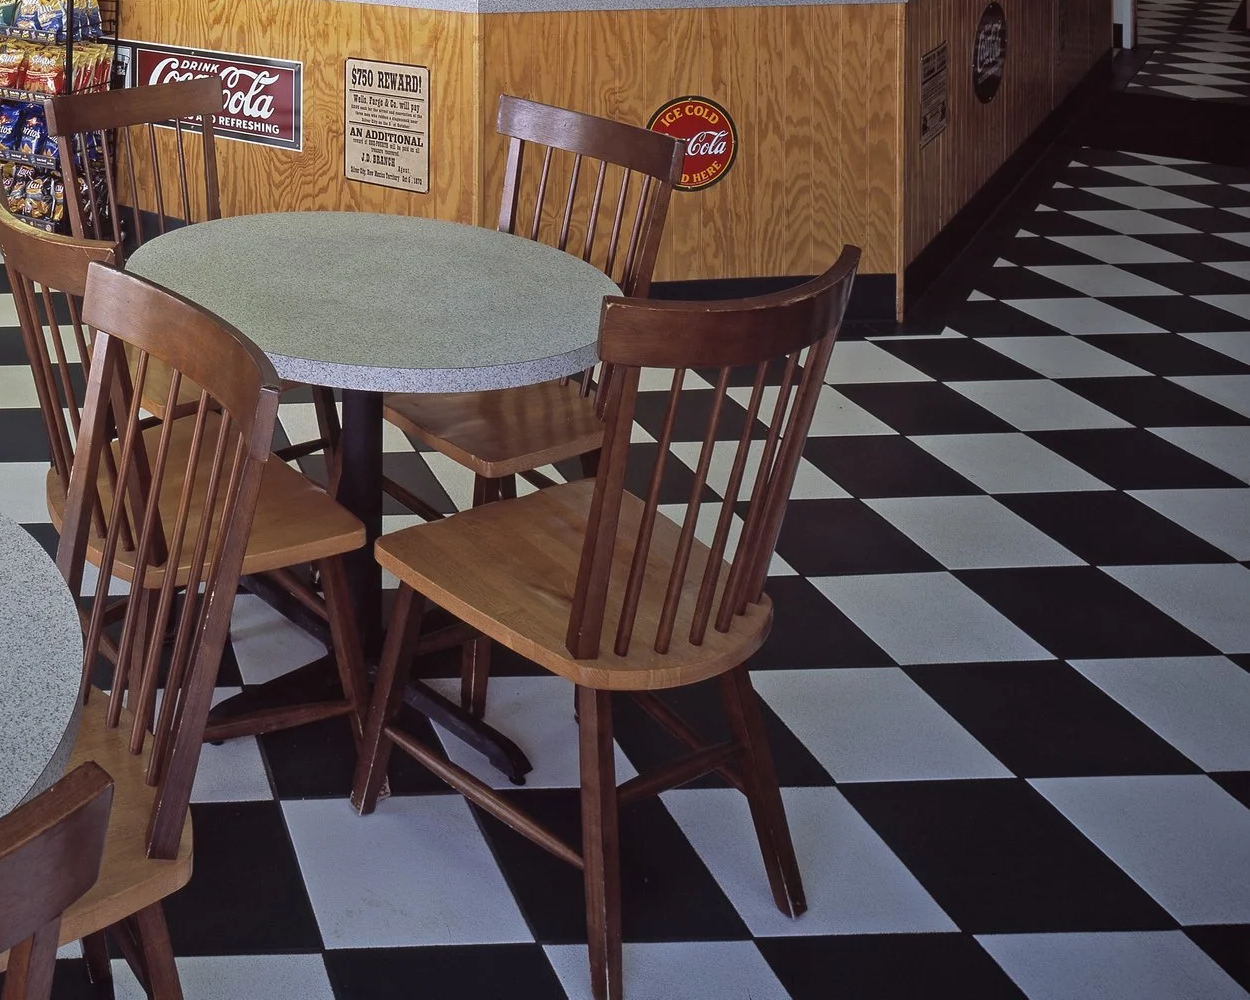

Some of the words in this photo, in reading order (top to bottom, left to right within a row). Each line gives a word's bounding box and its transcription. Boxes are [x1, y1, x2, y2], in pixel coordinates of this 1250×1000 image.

[180, 59, 220, 74] DRINK
[351, 64, 374, 88] $750
[377, 71, 422, 94] REWARD!
[369, 96, 383, 108] Fargo
[399, 101, 410, 110] will
[410, 104, 420, 113] pay
[219, 115, 280, 135] REFRESHING
[660, 107, 683, 128] ICE
[684, 104, 719, 125] COLD
[349, 126, 363, 138] AN
[365, 128, 423, 148] ADDITIONAL
[361, 152, 372, 163] J.D.
[373, 154, 396, 167] BRANCH
[374, 170, 386, 179] Mexico
[386, 172, 400, 182] Territory
[693, 160, 722, 182] HERE
